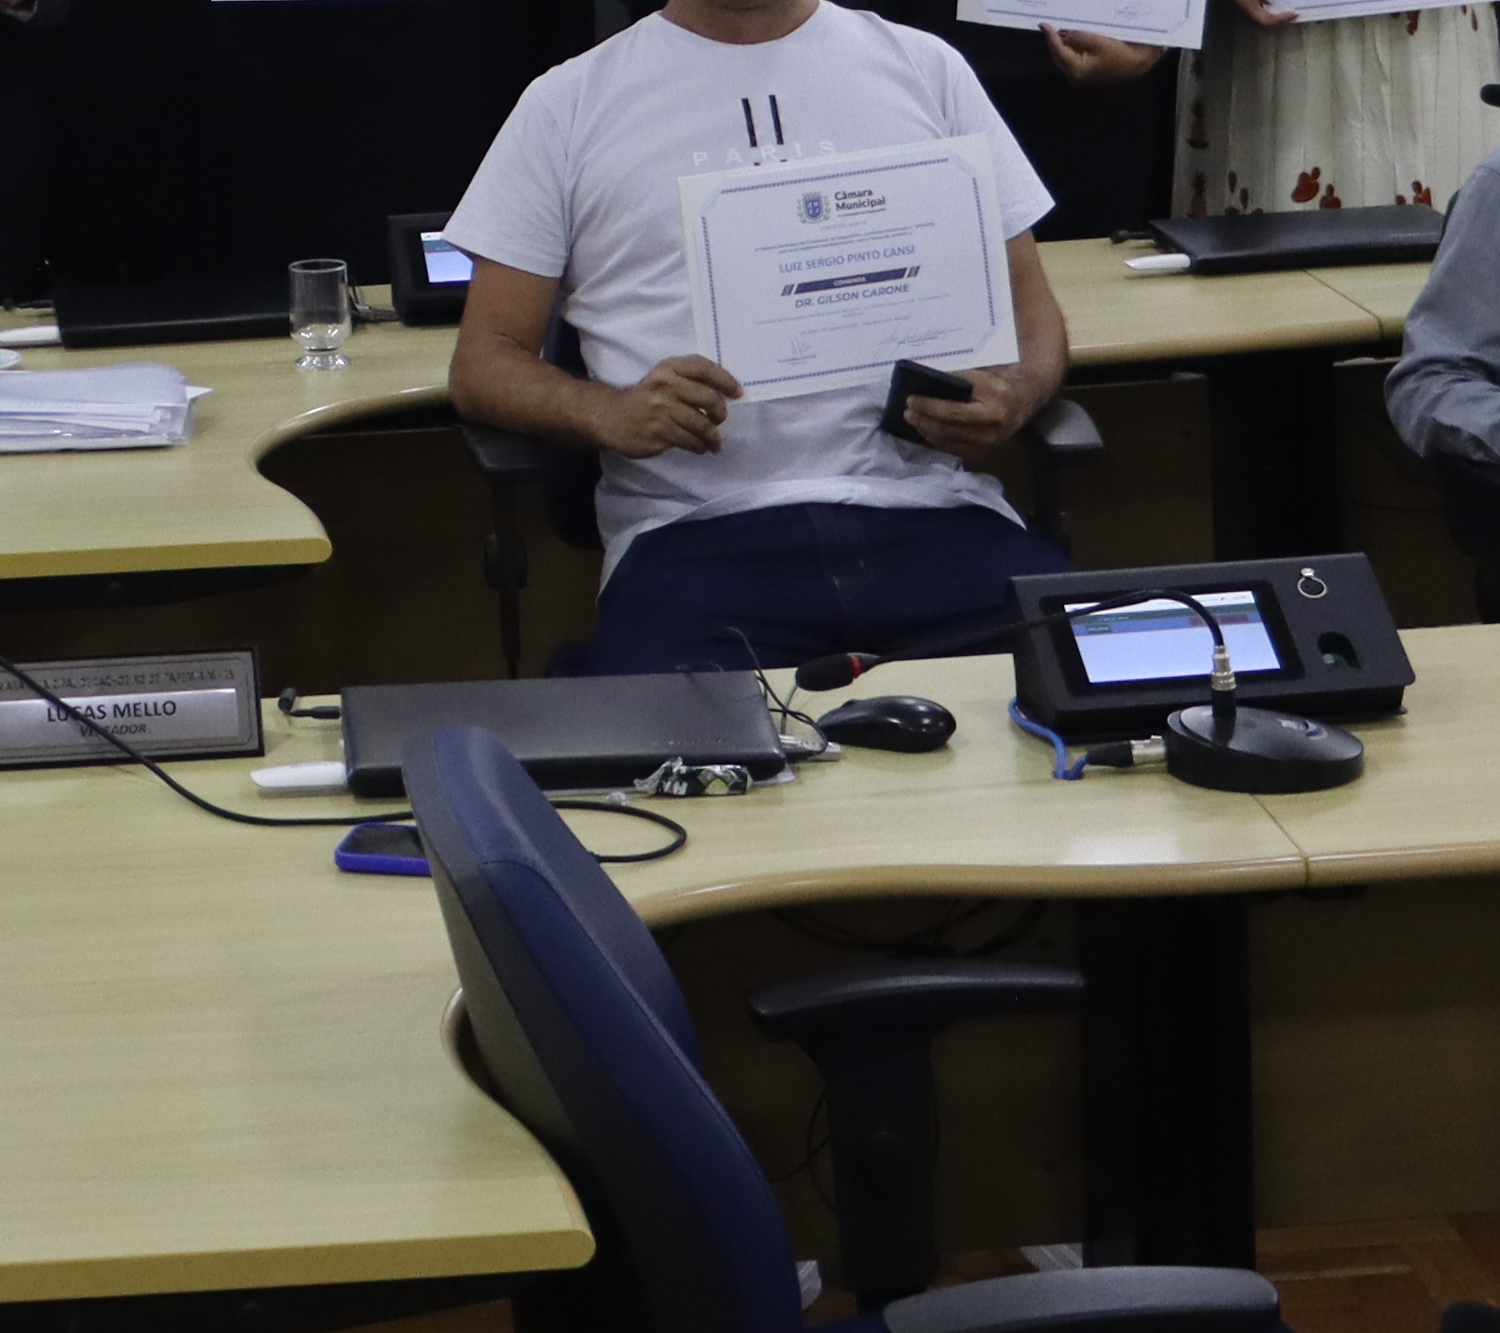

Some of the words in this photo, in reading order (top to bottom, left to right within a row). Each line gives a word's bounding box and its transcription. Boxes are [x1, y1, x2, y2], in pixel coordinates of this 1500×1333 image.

[692, 141, 836, 167] PARIS
[834, 188, 873, 201] Câmara
[835, 196, 887, 212] Municipal
[779, 260, 804, 273] LUIZ
[805, 254, 844, 270] SERGIO
[847, 249, 881, 264] PINTO
[883, 244, 915, 259] CANSI
[795, 295, 814, 308] DR.
[817, 290, 859, 305] GILSON
[861, 283, 910, 300] CARONE
[113, 700, 176, 719] MELLO
[79, 724, 146, 738] VEEADOR
